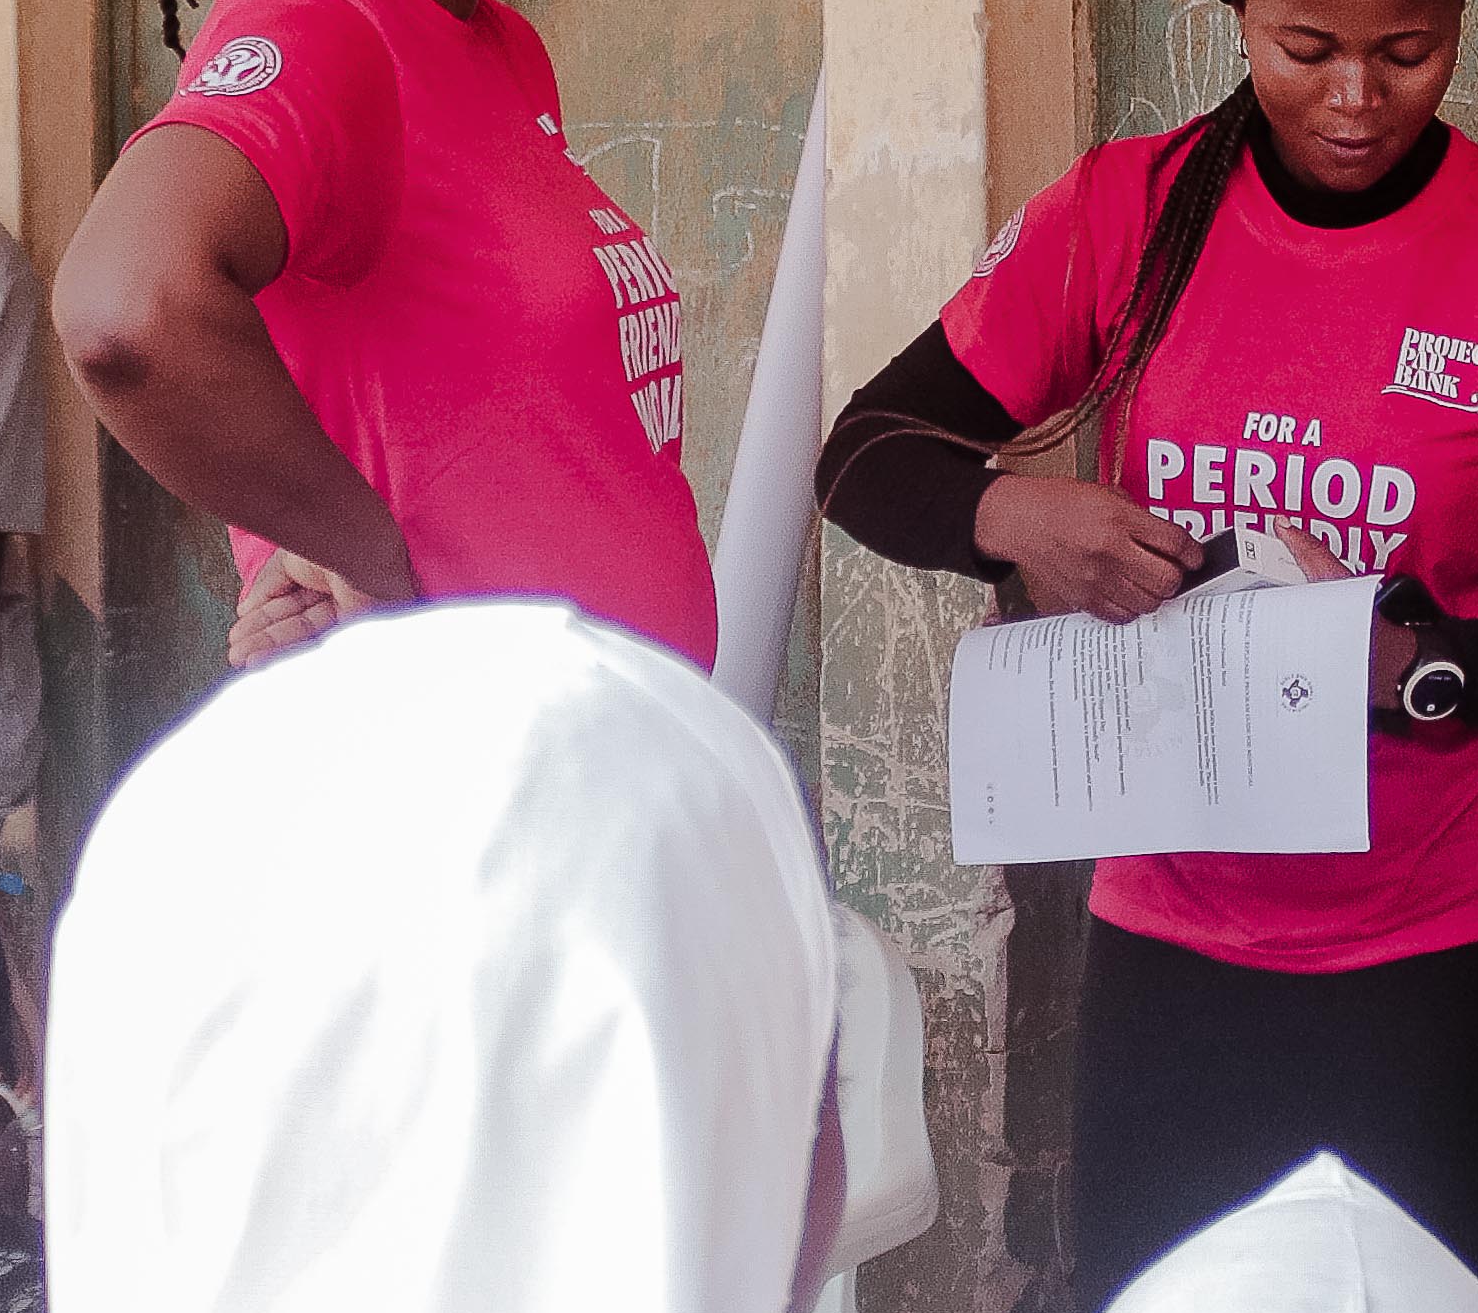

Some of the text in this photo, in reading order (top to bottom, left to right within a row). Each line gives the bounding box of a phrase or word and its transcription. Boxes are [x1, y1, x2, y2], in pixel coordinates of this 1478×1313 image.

[1397, 346, 1446, 374] PAD
[1393, 362, 1461, 399] BANK
[1243, 412, 1322, 447] FOR A
[1147, 438, 1416, 526] PERIOD
